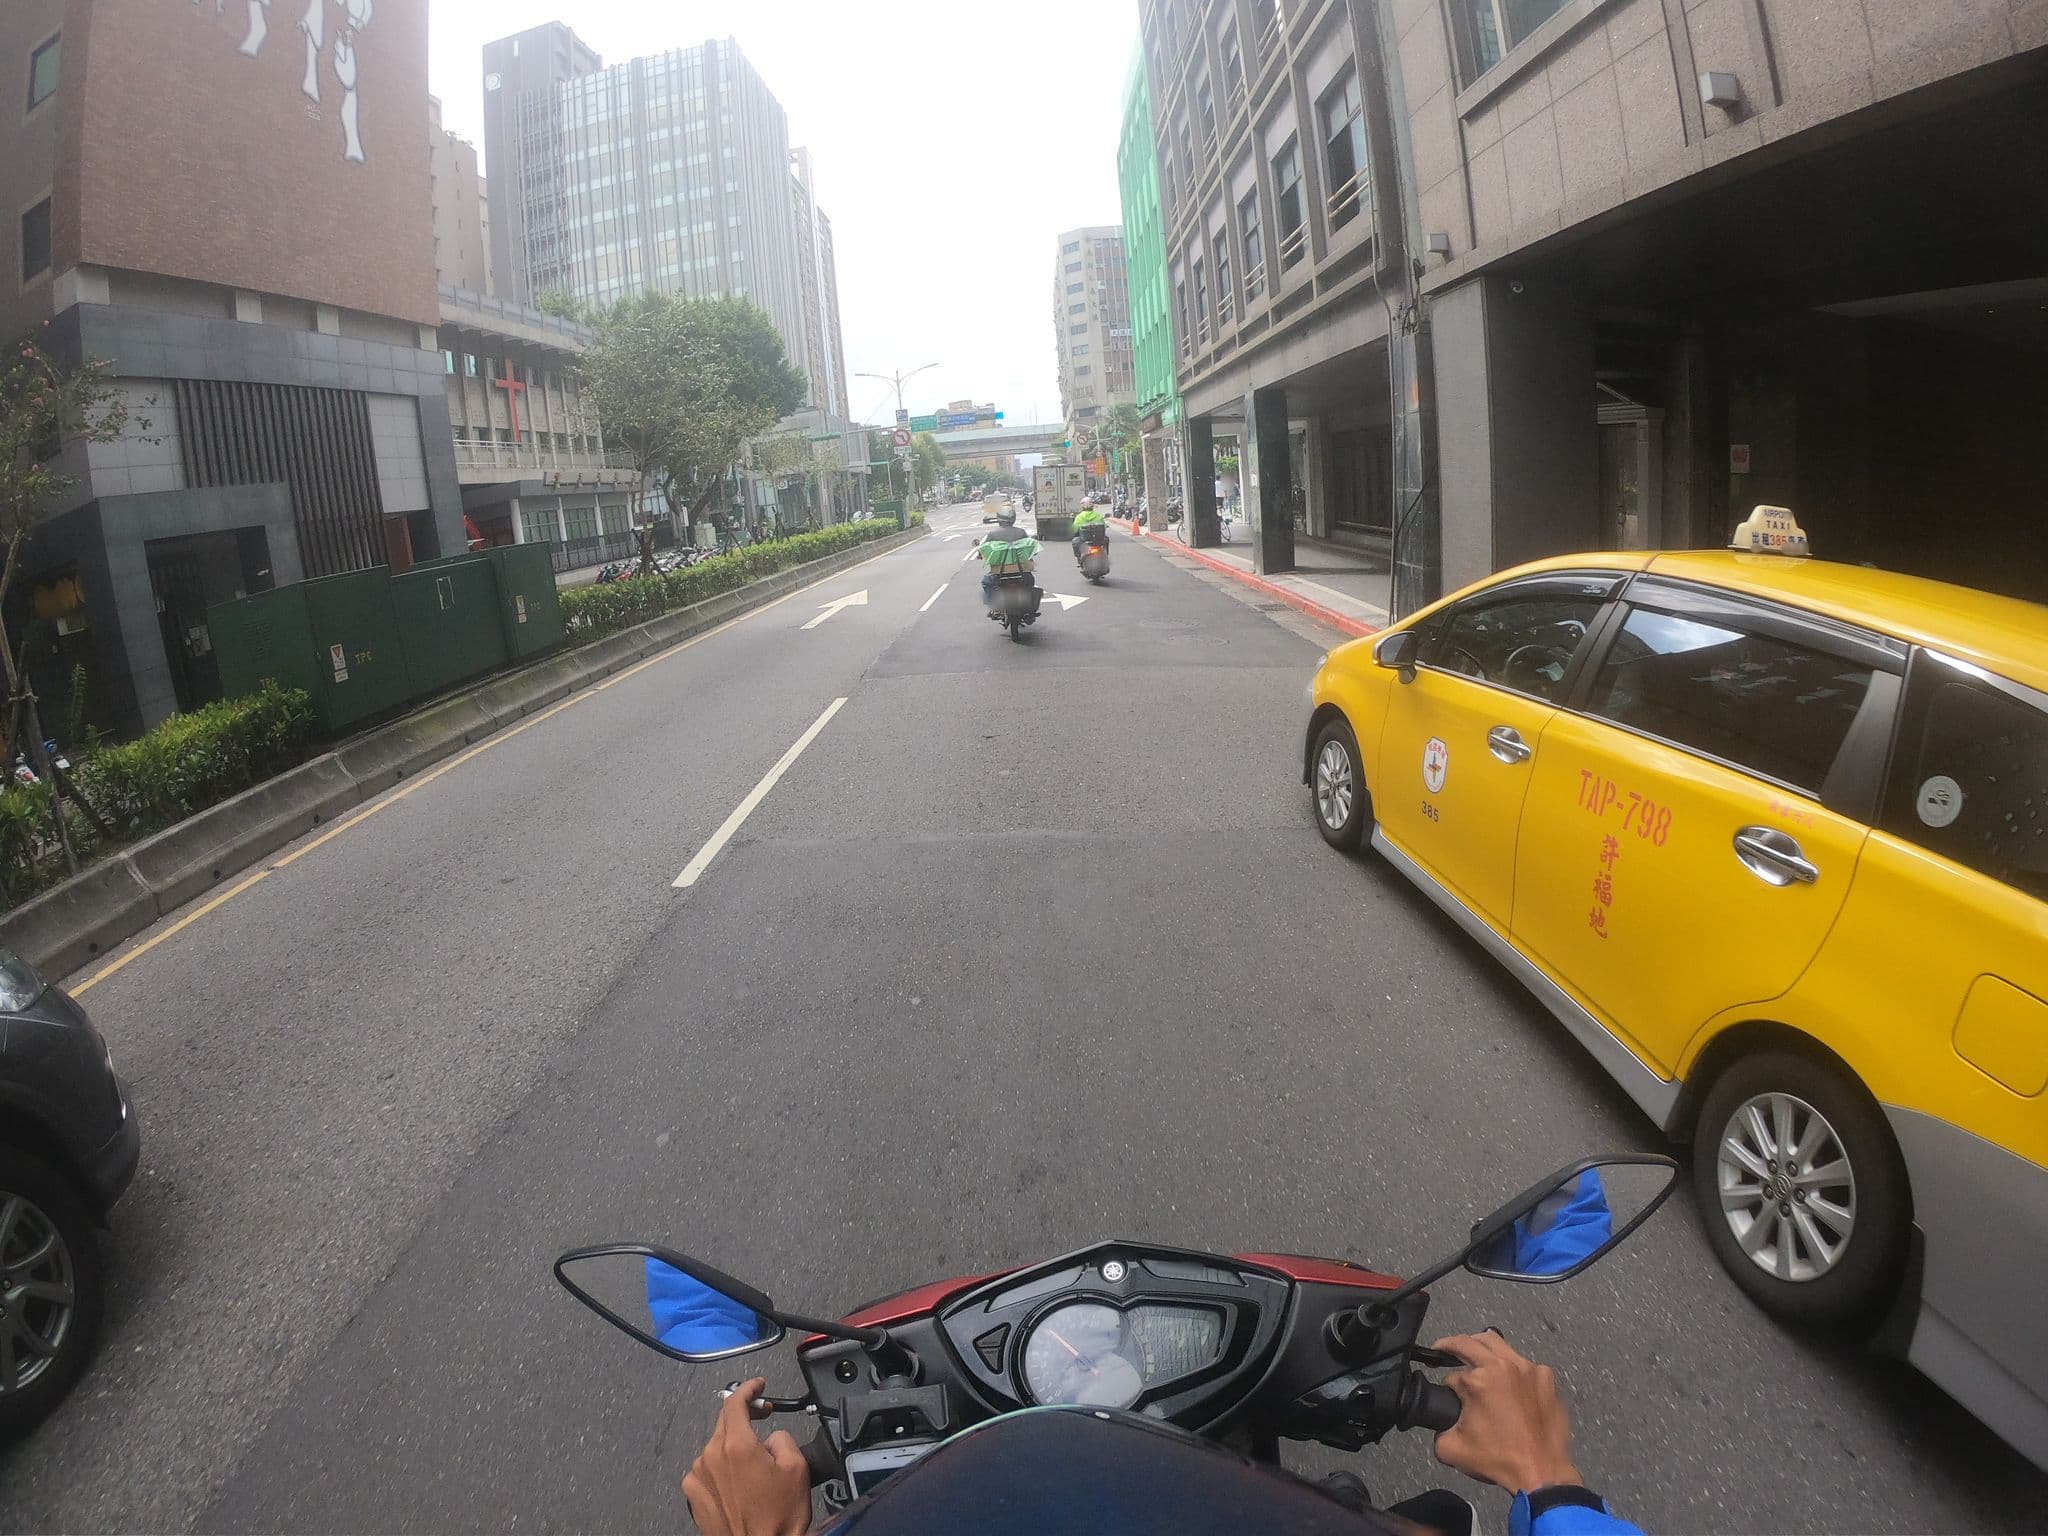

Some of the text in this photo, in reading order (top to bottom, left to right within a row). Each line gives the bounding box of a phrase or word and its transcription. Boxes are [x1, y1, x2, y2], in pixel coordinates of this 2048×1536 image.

[1766, 519, 1790, 530] TAXI
[1421, 800, 1439, 822] 385
[1578, 769, 1672, 847] TAP-798
